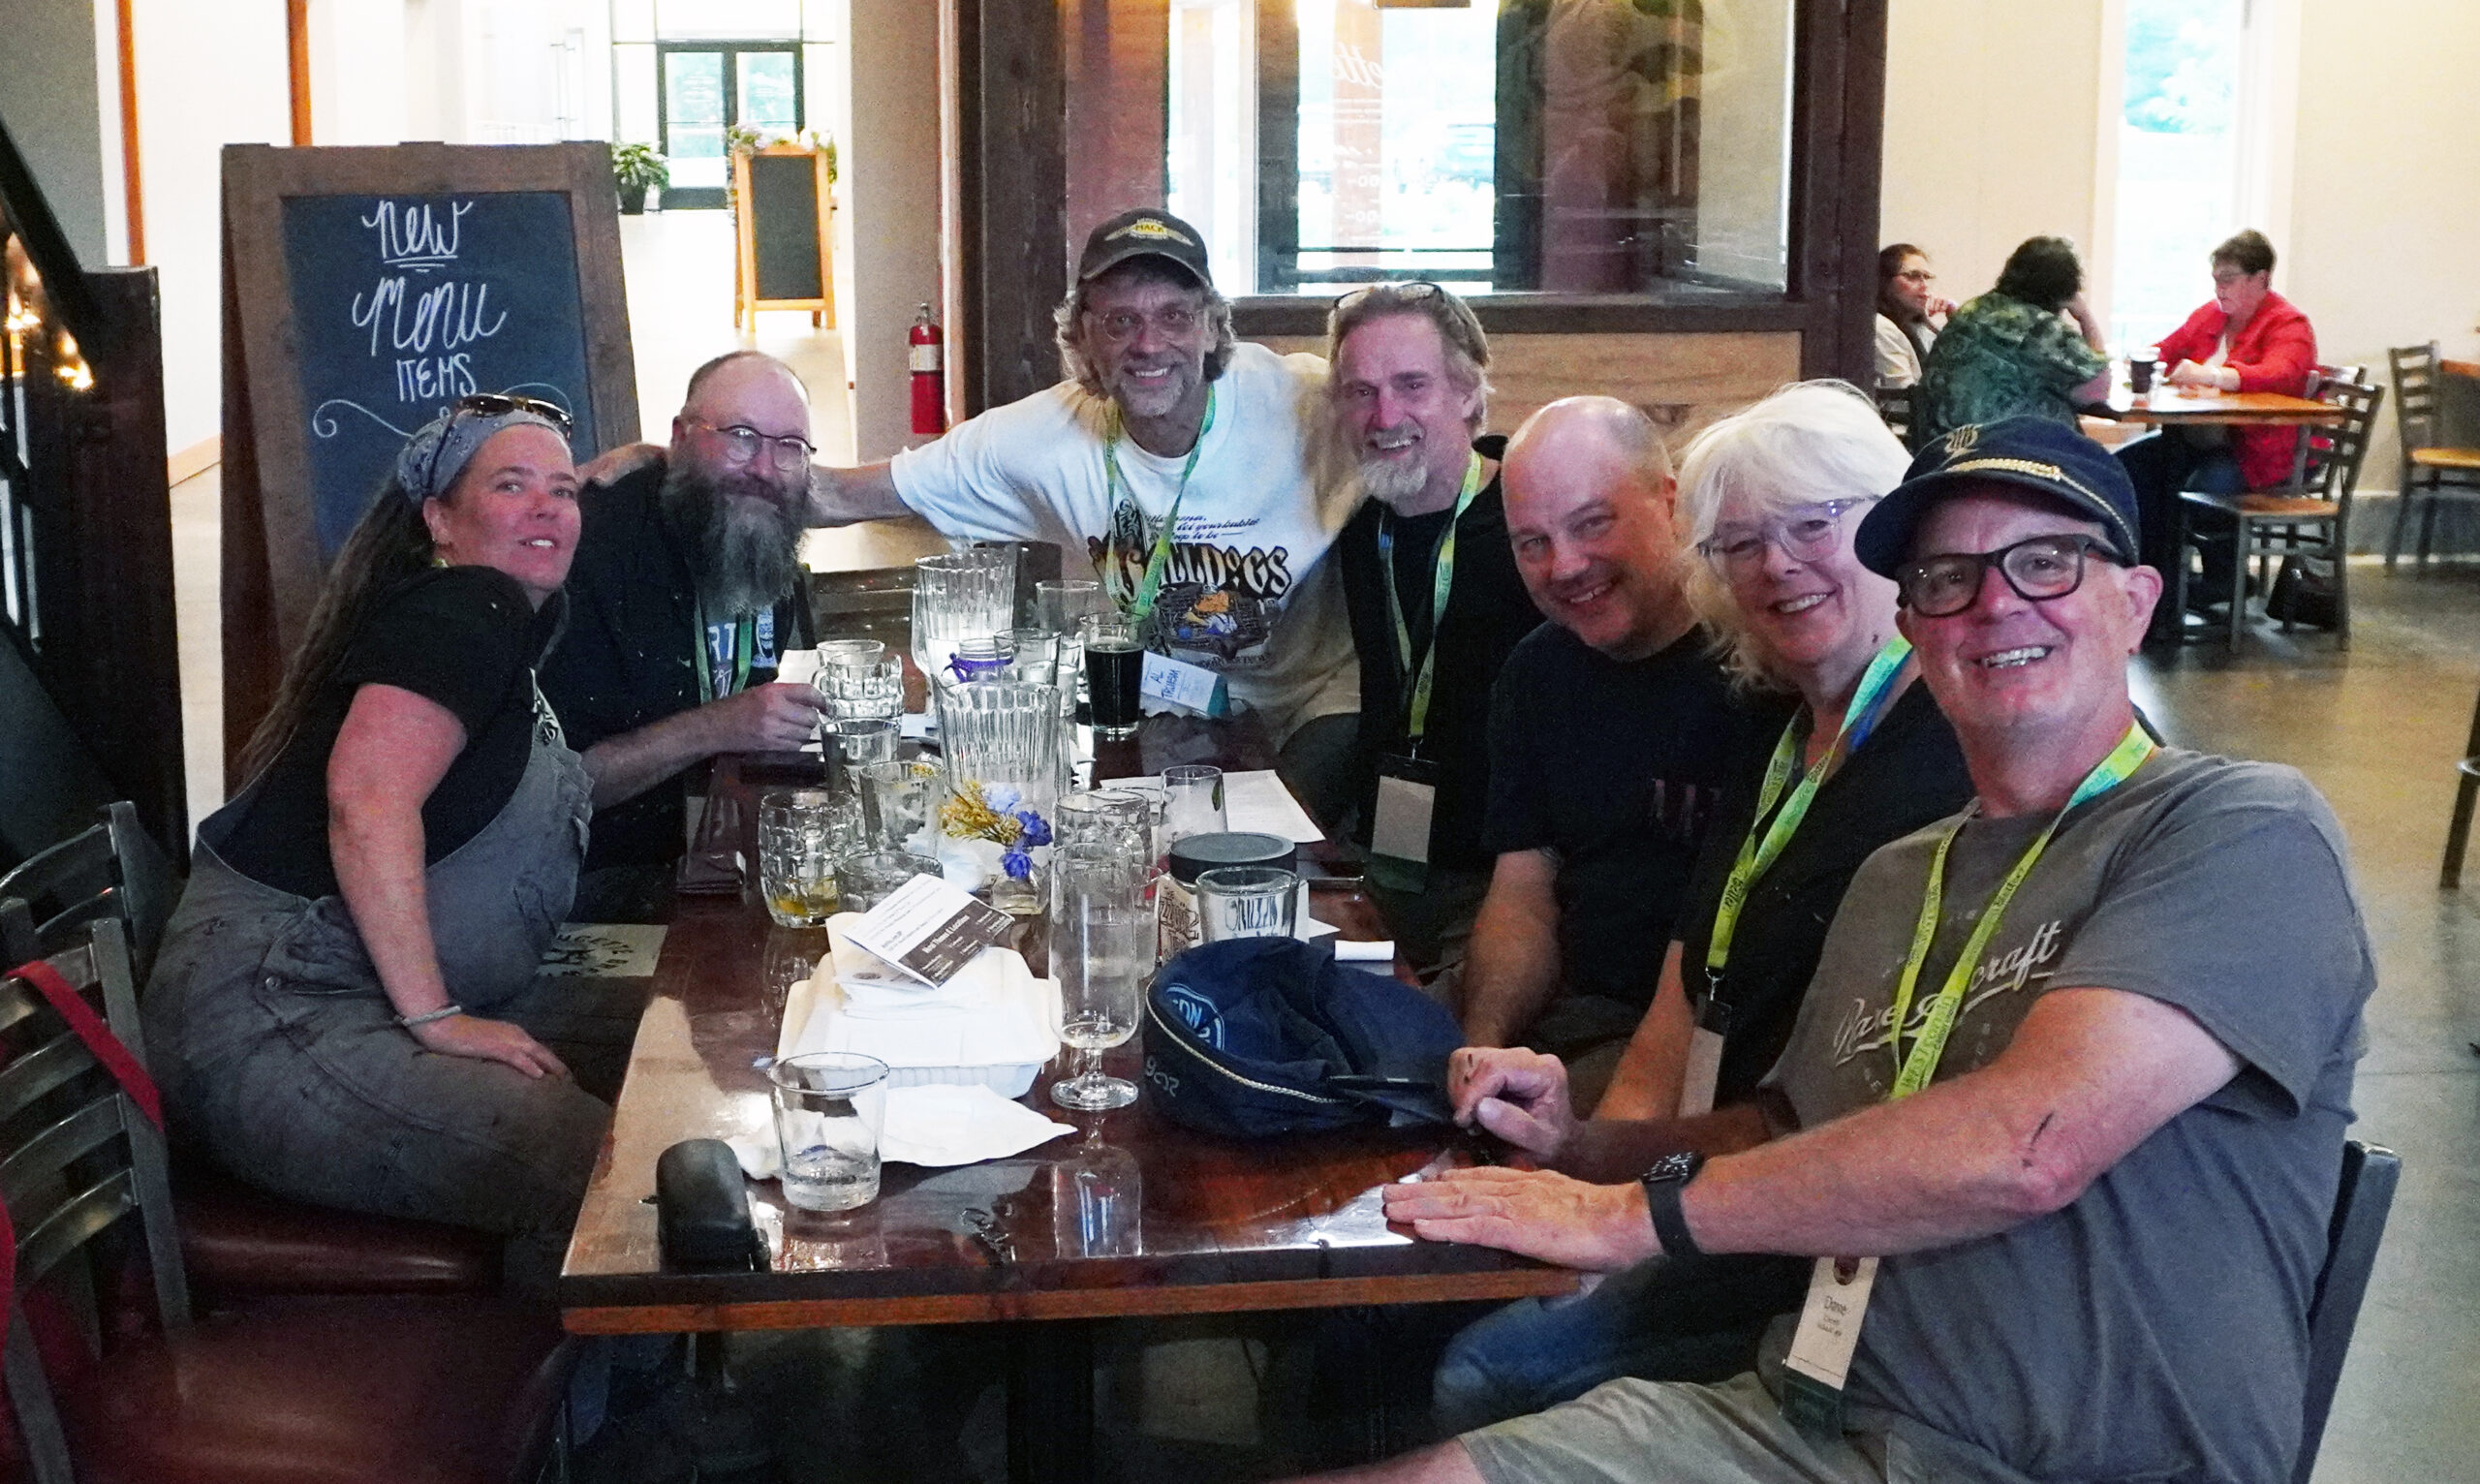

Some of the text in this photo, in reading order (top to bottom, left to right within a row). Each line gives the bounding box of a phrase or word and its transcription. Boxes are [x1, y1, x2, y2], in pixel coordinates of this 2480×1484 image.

[361, 200, 474, 259] New
[352, 276, 507, 356] Menu
[396, 353, 477, 402] ITEMS
